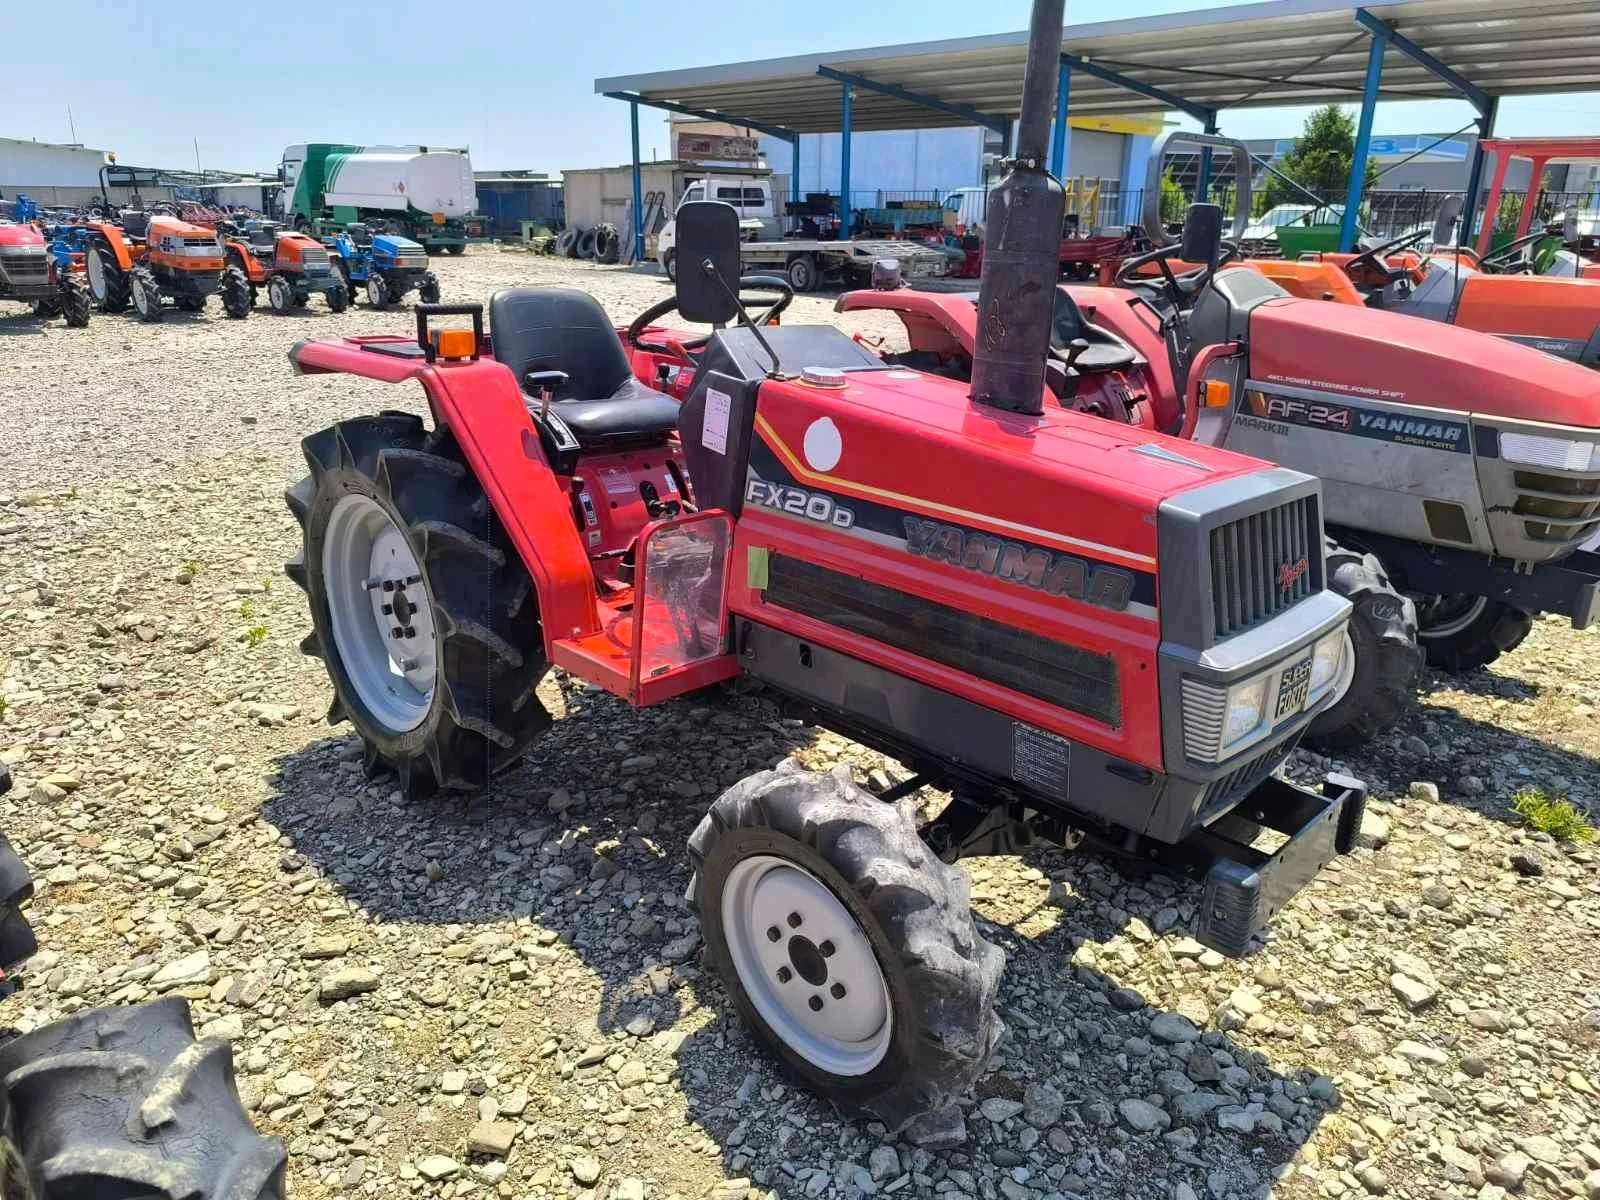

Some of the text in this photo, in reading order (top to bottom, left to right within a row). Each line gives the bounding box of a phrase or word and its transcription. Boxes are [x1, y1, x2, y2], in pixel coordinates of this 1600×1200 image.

[1359, 414, 1462, 440] YANMAR
[1394, 435, 1456, 450] SUPER FORTE
[745, 480, 854, 528] FX20D
[904, 516, 1135, 611] YANMAR
[1281, 659, 1312, 688] SUPER
[1279, 680, 1308, 714] FORTE
